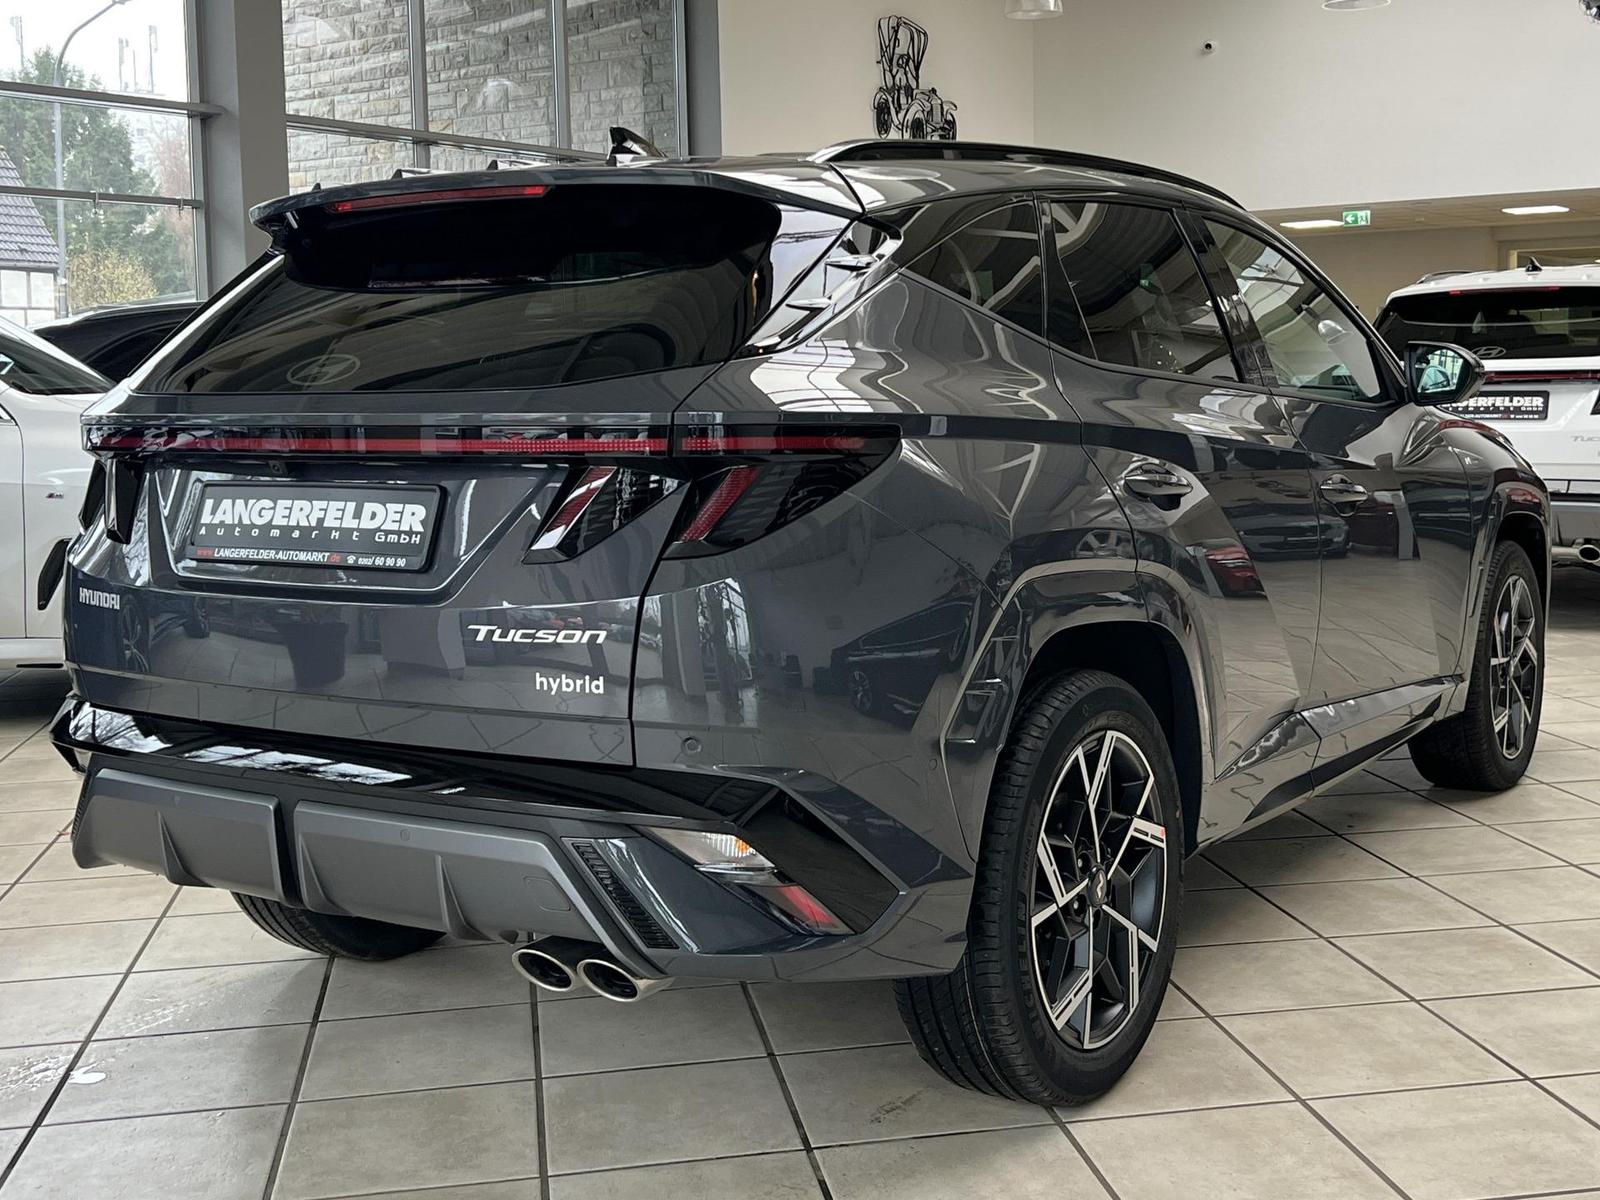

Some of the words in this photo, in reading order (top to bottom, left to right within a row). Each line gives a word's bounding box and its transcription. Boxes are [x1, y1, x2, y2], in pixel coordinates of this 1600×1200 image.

[200, 498, 426, 532] LANGERFELDER
[374, 531, 421, 545] GmbH
[375, 556, 385, 566] 60
[385, 557, 395, 566] 90
[396, 558, 406, 567] 90
[79, 586, 120, 610] HYUNDAI
[467, 624, 607, 644] Tucson
[535, 672, 605, 695] hybrid
